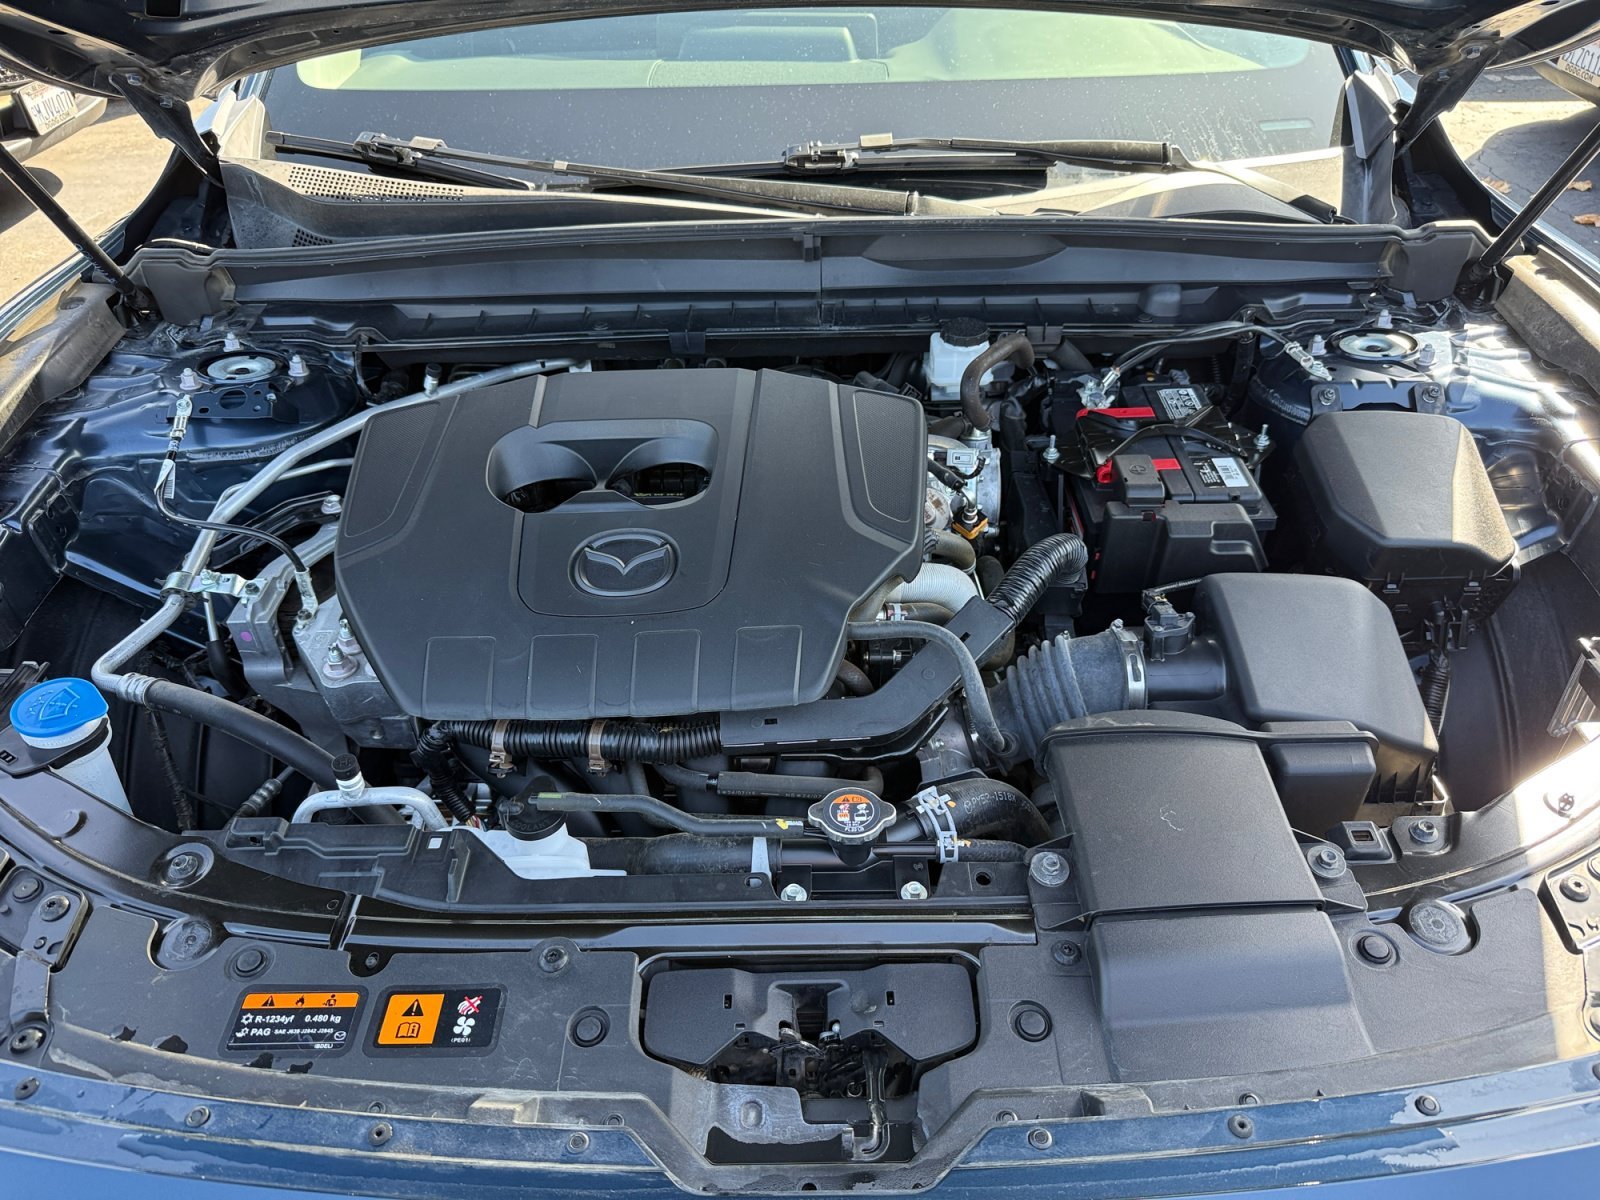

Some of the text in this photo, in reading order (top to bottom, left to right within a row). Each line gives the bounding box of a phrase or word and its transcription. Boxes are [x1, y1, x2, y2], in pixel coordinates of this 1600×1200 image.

[255, 1014, 342, 1025] R-1234yf 0.480 kg
[250, 1028, 271, 1037] PAG
